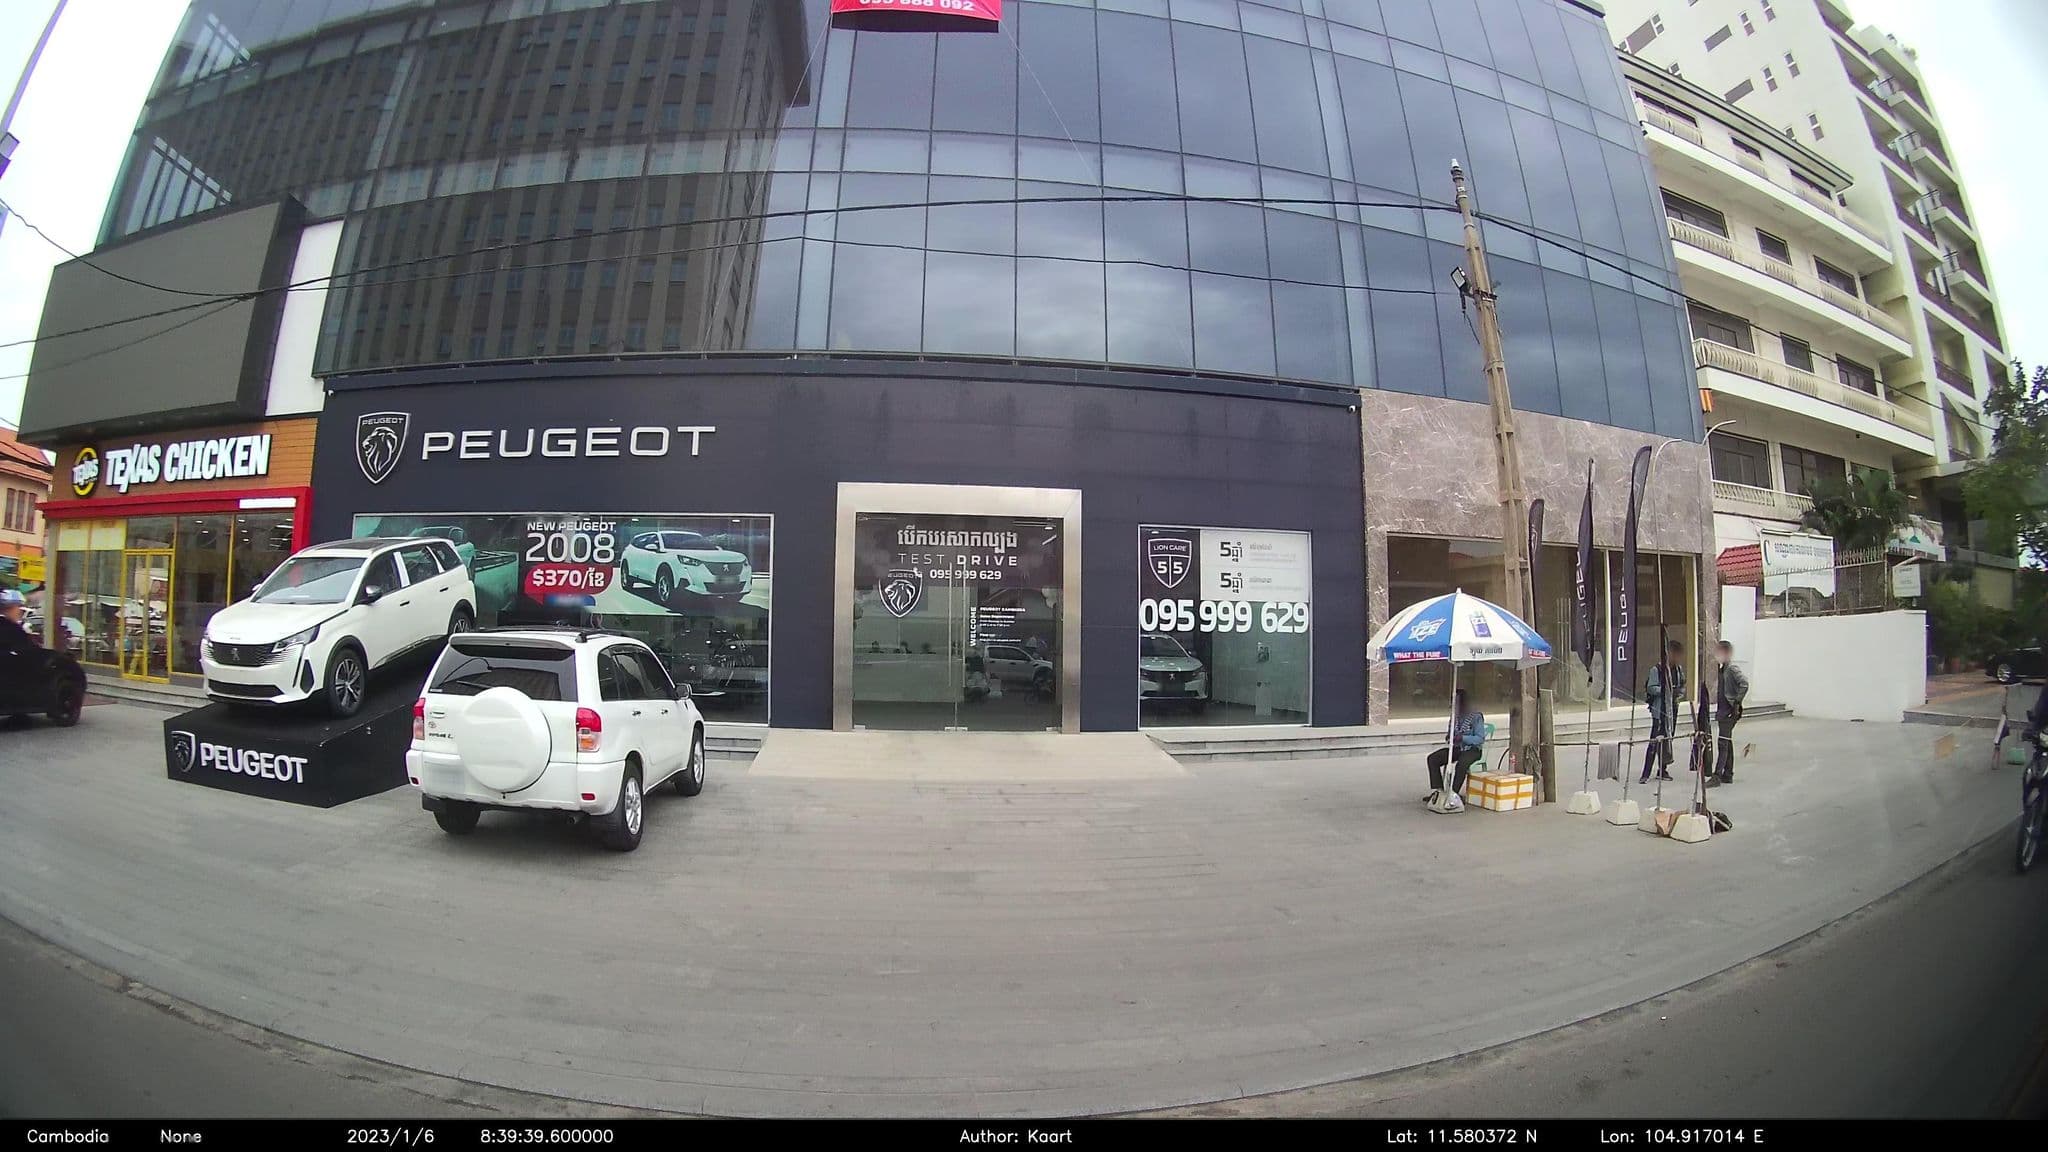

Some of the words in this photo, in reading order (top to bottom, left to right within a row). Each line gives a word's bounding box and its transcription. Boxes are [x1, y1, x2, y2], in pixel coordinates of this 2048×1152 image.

[362, 417, 404, 426] PEUGEOT
[421, 426, 716, 460] PEUGEOT
[105, 443, 160, 493] TEXAS
[163, 434, 271, 482] CHICKEN
[527, 521, 555, 531] NEW
[558, 521, 616, 532] PEUGEOT
[525, 532, 615, 563] 2008
[1169, 544, 1187, 552] CARE
[898, 553, 945, 565] TEST
[957, 555, 1018, 566] DRIVE
[929, 569, 950, 579] 095
[954, 570, 977, 579] 999
[979, 570, 1002, 580] 629
[1157, 561, 1168, 574] 5
[1172, 561, 1183, 575] 5
[1140, 598, 1195, 632] 095
[1199, 600, 1253, 633] 999
[1261, 602, 1309, 633] 629
[1393, 651, 1412, 659] WHAT
[1413, 651, 1424, 659] THE
[200, 742, 308, 784] PEUGEOT
